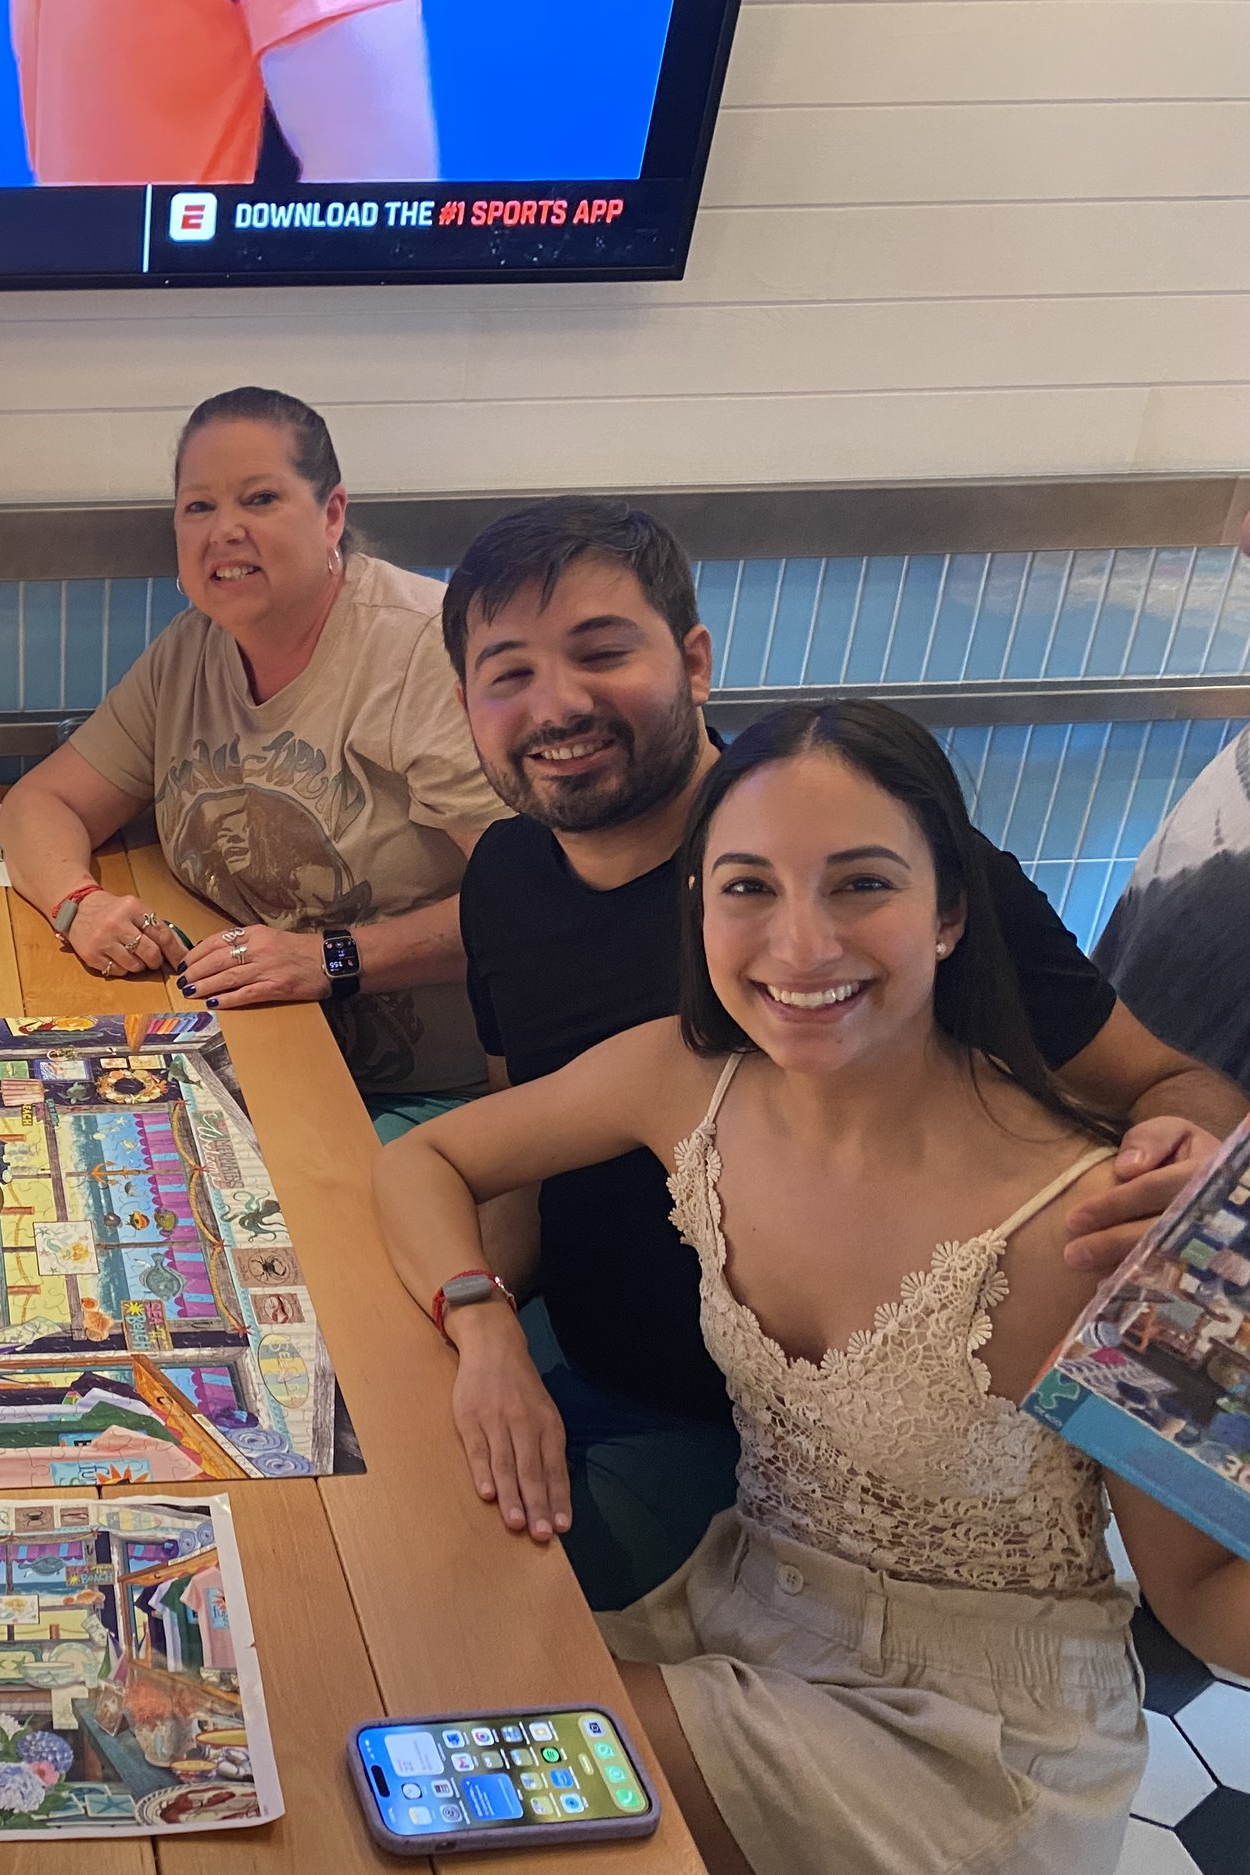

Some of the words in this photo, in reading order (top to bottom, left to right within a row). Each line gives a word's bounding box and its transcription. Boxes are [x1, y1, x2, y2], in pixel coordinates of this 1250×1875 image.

[235, 202, 378, 228] DOWNLOAD
[385, 201, 435, 226] THE
[438, 202, 465, 226] #1
[470, 200, 566, 226] SPORTS
[572, 200, 624, 224] APP
